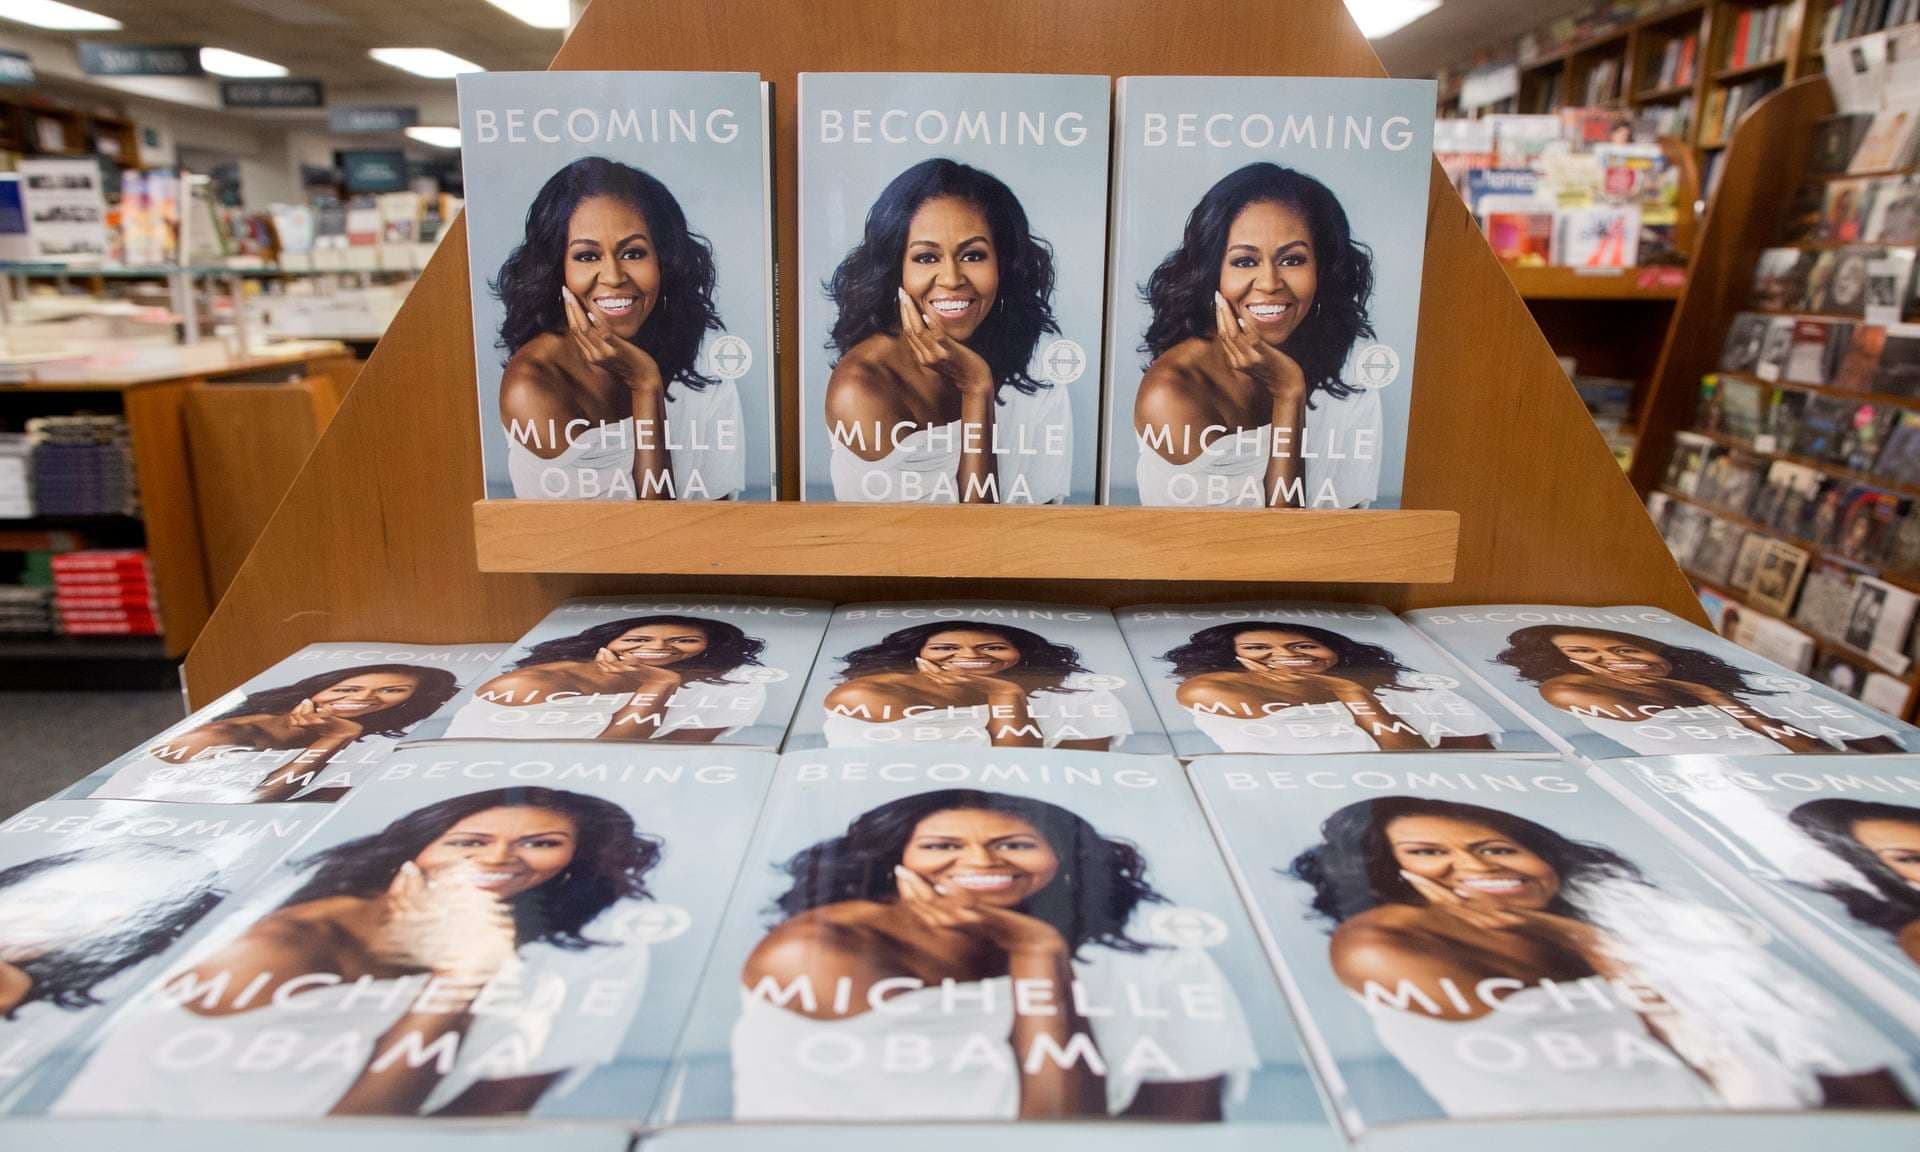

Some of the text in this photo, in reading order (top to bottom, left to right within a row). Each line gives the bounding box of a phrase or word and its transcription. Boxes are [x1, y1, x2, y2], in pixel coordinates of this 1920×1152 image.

[475, 108, 740, 144] BECOMING
[820, 109, 1088, 146] BECOMING
[1143, 112, 1414, 151] BECOMING
[508, 418, 737, 450] MICHELLE
[831, 420, 1065, 456] MICHELLE
[1139, 423, 1377, 460] MICHELLE
[540, 467, 710, 500] OBAMA
[861, 469, 1035, 504] OBAMA
[1167, 473, 1341, 508] OBAMA
[564, 603, 809, 616] BECOMING
[844, 607, 1093, 622] BECOMING
[1132, 608, 1377, 622] BECOMING
[1428, 611, 1673, 626] BECOMING
[299, 650, 500, 662] BECOMIN
[474, 690, 756, 710] MICHELLE
[831, 703, 1118, 720] MICHELLE
[1190, 701, 1476, 716] MICHELLE
[1568, 704, 1859, 720] MICHELLE
[489, 710, 706, 728] OBAMA
[1240, 721, 1464, 738] OBAMA
[863, 724, 1090, 741] OBAMA
[1636, 724, 1863, 741] OBAMA
[149, 745, 383, 764] MICHELL
[378, 759, 740, 784] BECOMING
[795, 762, 1159, 790] BECOMING
[1223, 770, 1580, 794] BECOMING
[1, 815, 301, 838] BECOMIN
[742, 974, 1228, 1021] MICHELLE
[1362, 976, 1692, 1016] MICHE
[152, 1027, 528, 1077] OBAMA
[796, 1031, 1184, 1078] OBAMA
